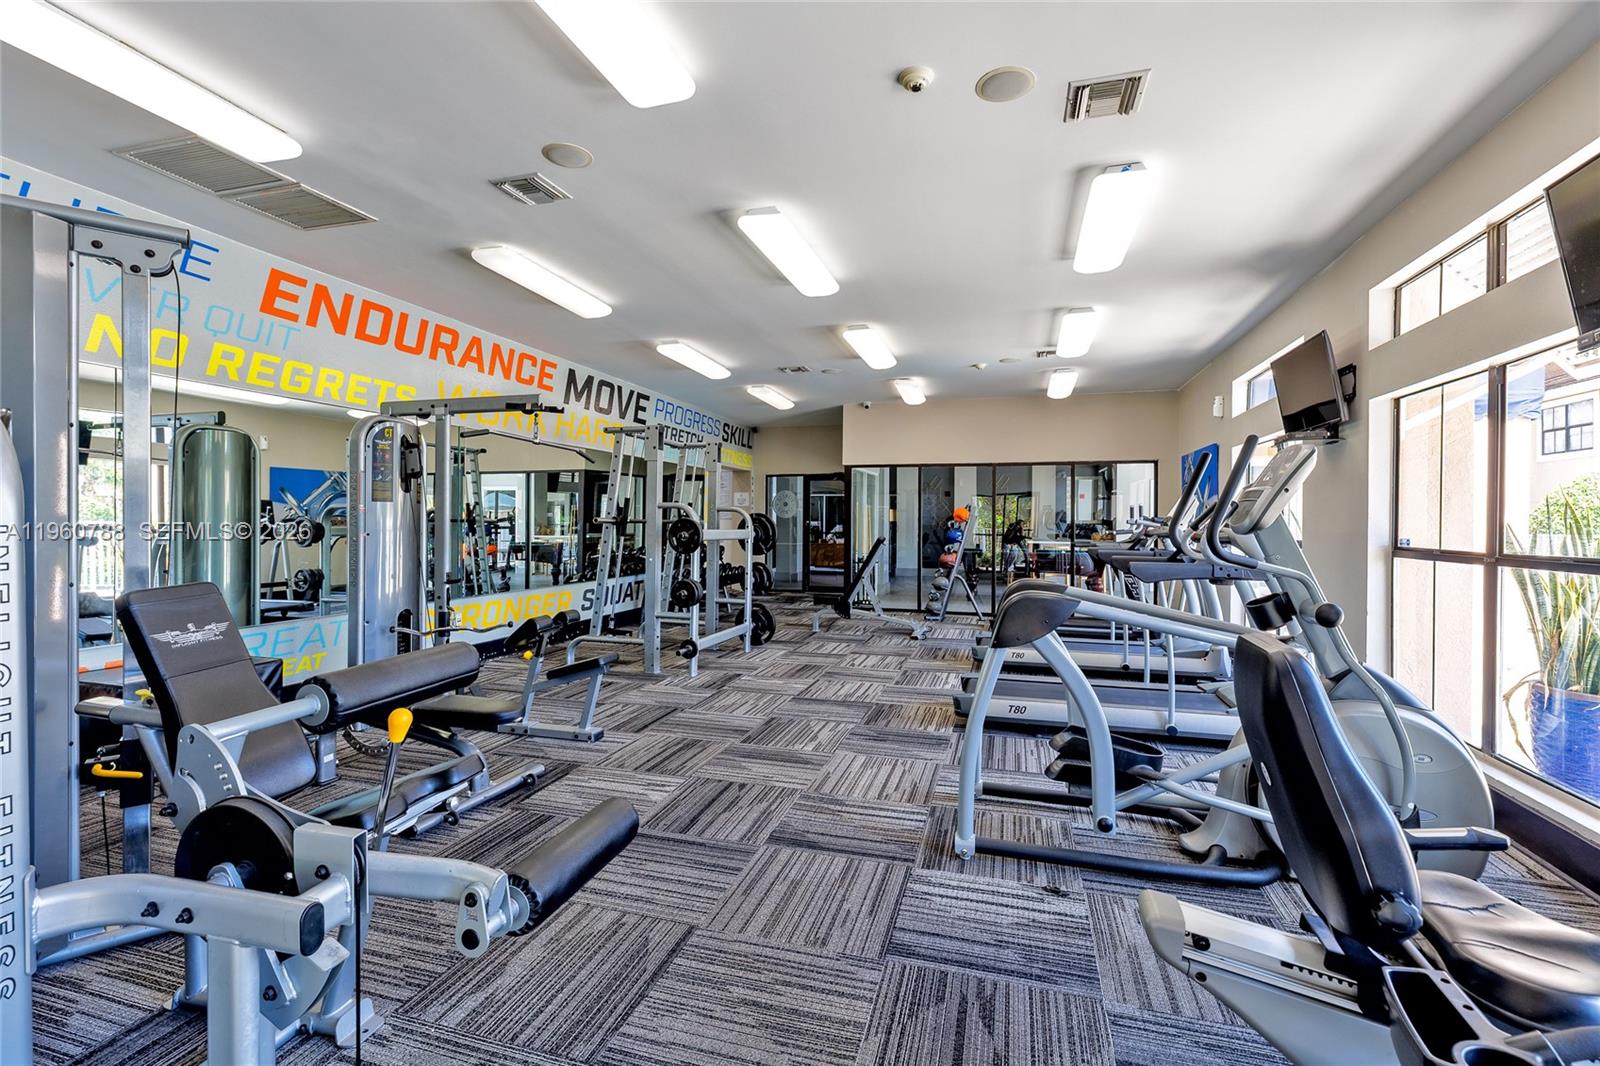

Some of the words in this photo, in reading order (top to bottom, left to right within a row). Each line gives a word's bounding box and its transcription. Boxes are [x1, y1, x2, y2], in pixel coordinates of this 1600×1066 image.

[203, 304, 301, 350] QUIT
[84, 313, 190, 369] NO
[206, 341, 418, 409] REGRETS
[259, 267, 558, 393] ENDURANCE
[563, 368, 651, 426] MOVE
[654, 398, 722, 438] PROGRESS
[721, 422, 753, 450] SKILL
[658, 423, 704, 444] TRETCH
[1011, 651, 1025, 659] T80
[1008, 704, 1027, 715] T80
